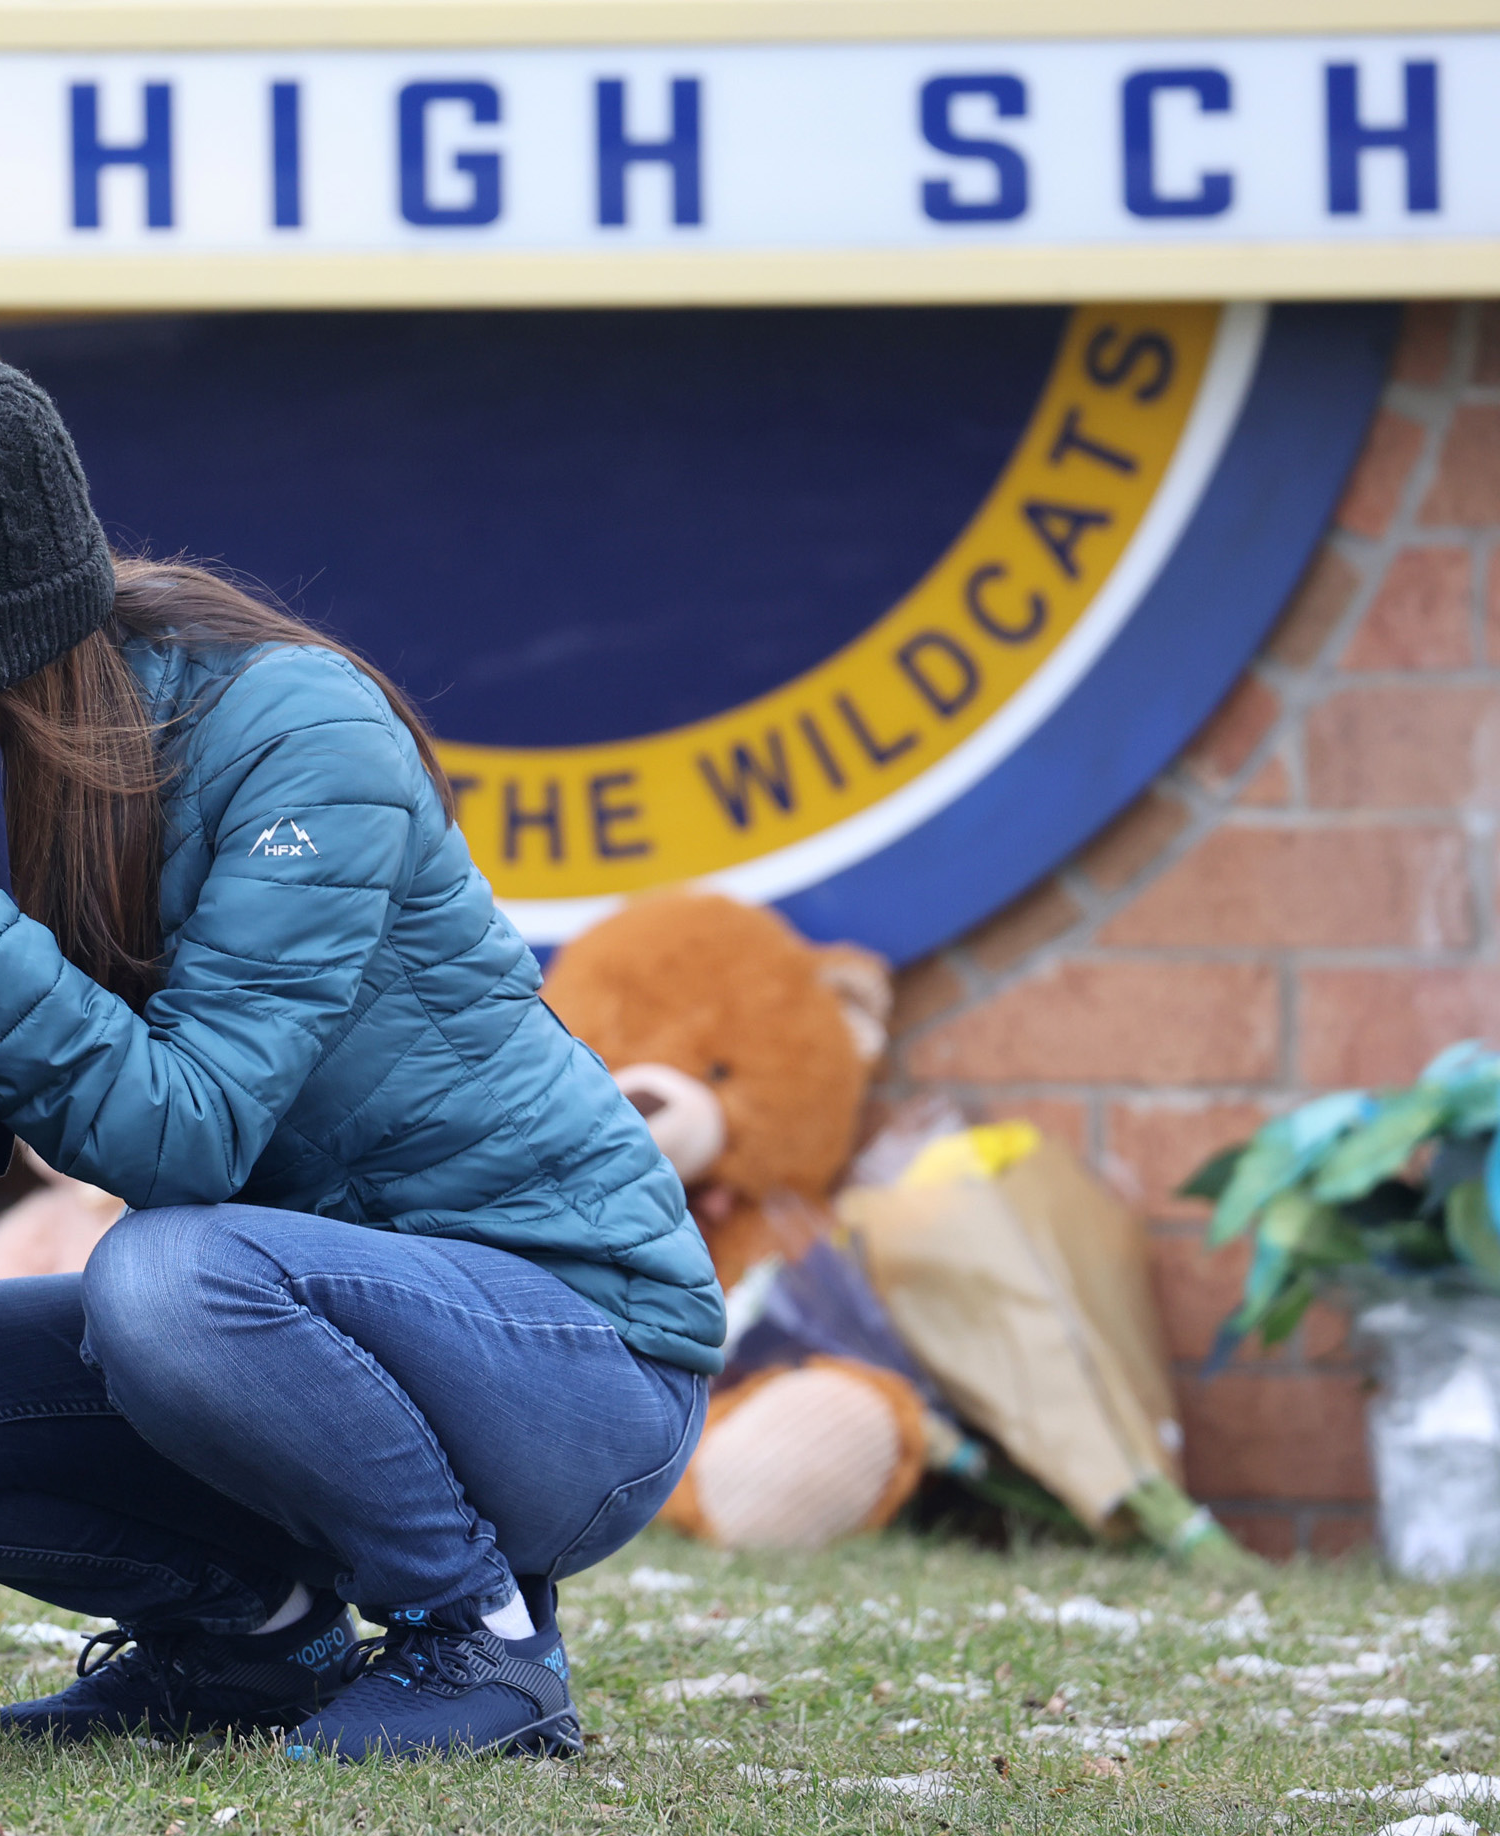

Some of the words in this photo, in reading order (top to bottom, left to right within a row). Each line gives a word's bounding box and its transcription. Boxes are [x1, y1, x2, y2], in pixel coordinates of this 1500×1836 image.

[70, 78, 702, 229] HIGH
[919, 60, 1441, 224] SCH
[698, 322, 1178, 835] WILDCATS
[264, 844, 303, 857] HFX
